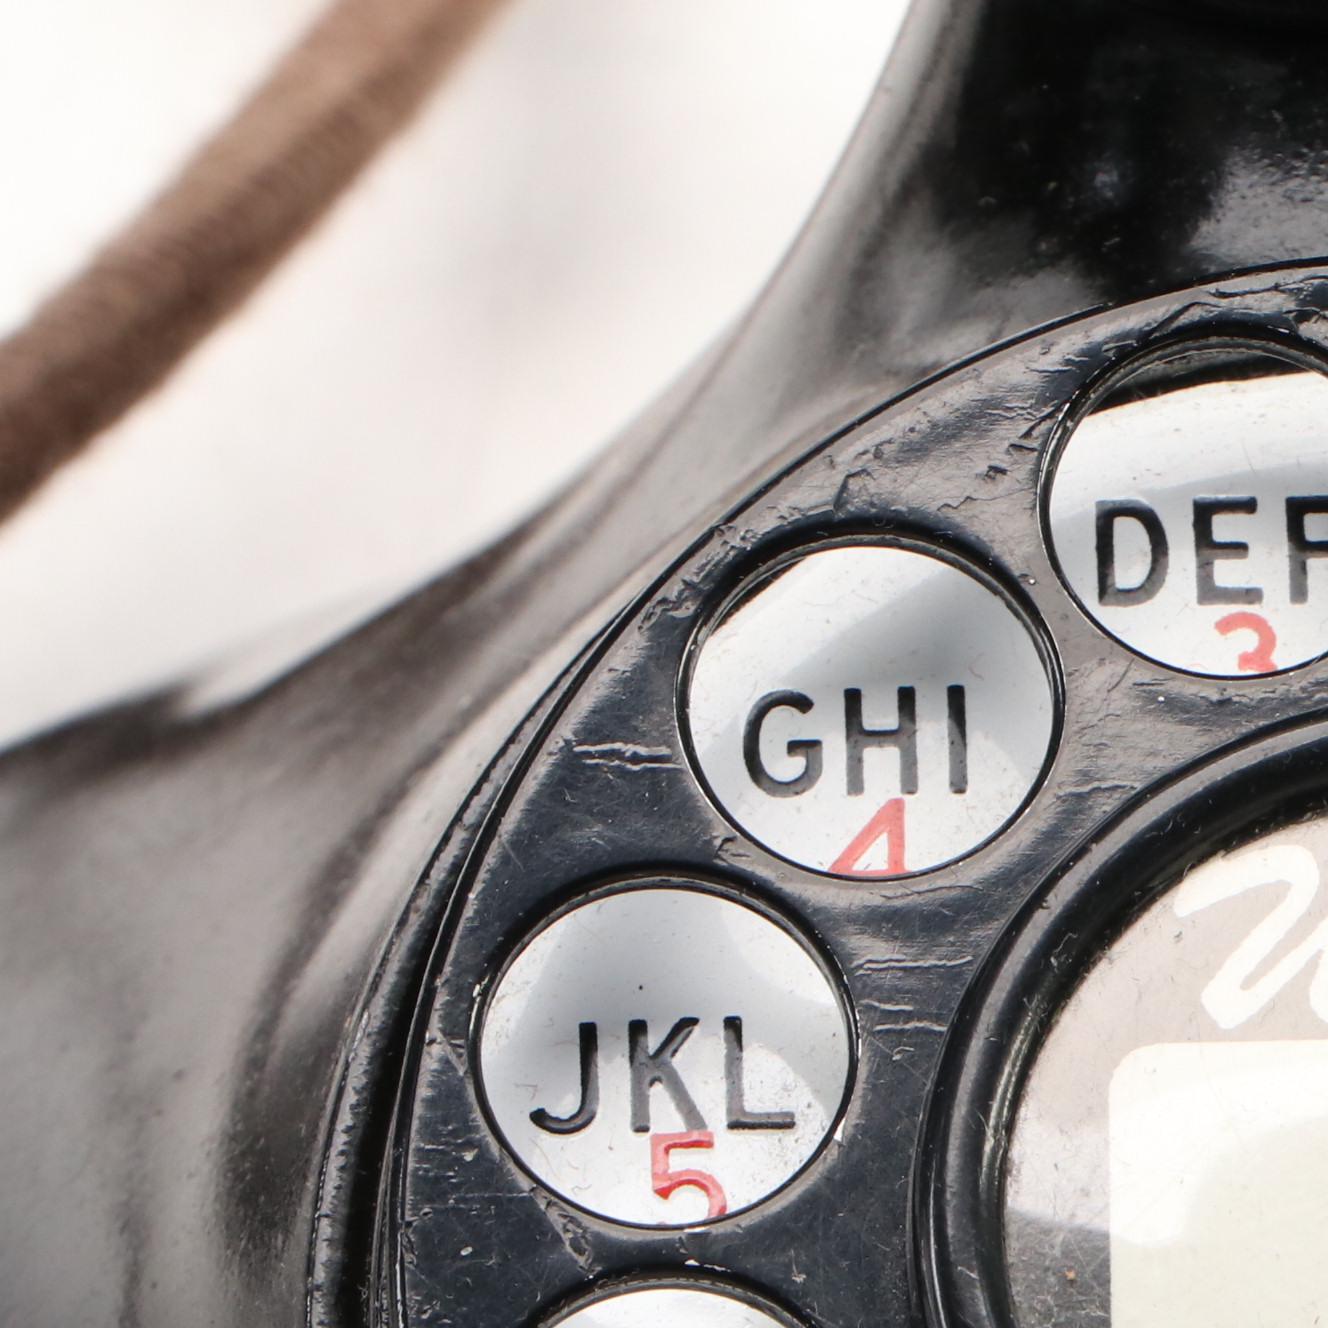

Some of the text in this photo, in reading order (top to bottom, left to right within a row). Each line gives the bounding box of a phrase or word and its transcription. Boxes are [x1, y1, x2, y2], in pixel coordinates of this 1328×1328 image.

[744, 685, 966, 798] GHI
[831, 799, 907, 876] 4
[531, 1015, 795, 1134] JKL
[651, 1132, 728, 1218] 5
